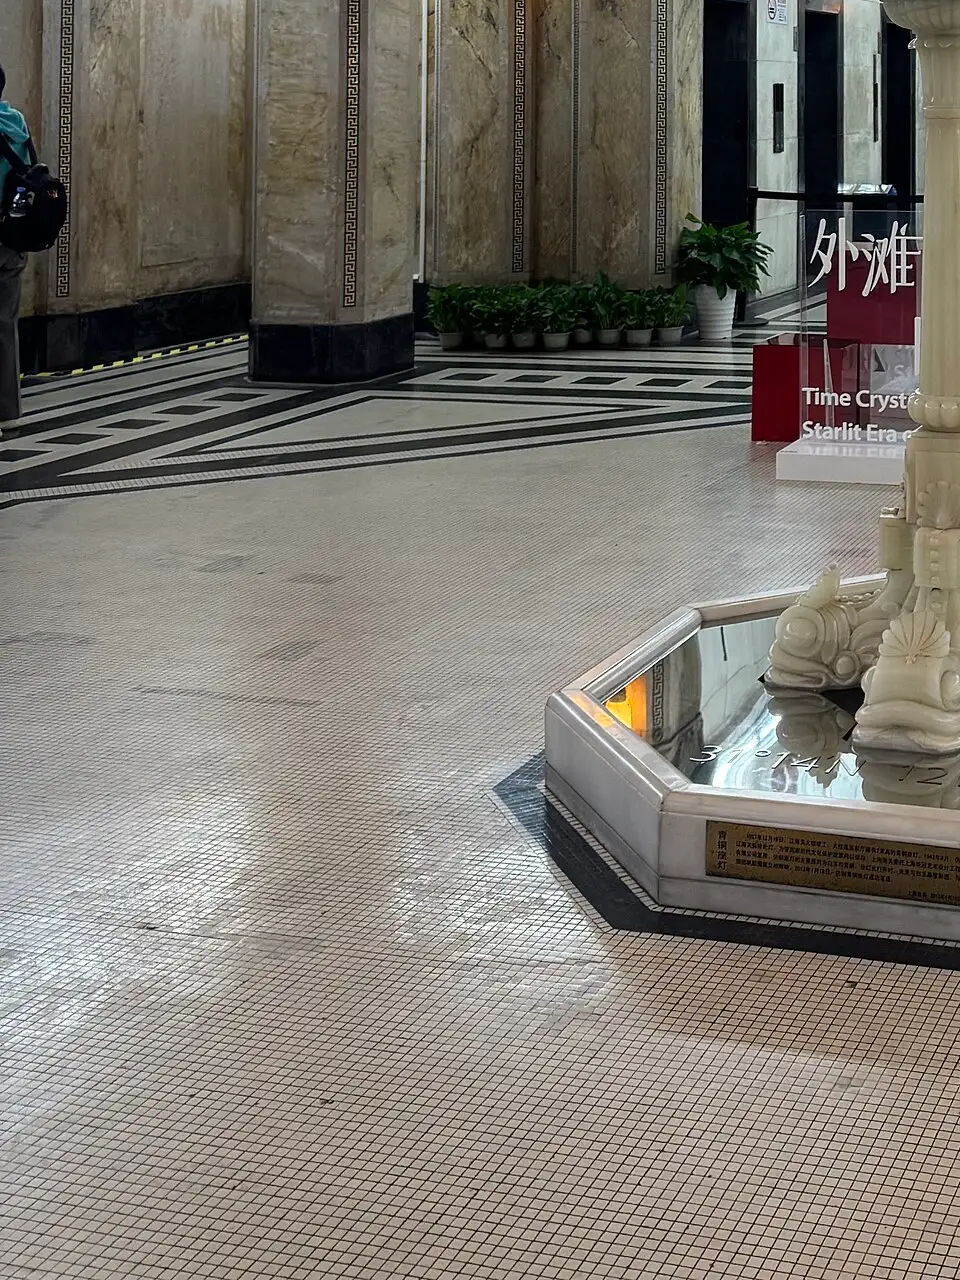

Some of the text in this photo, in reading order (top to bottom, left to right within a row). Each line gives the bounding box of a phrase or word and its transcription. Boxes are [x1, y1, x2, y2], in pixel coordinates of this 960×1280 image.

[802, 387, 911, 413] Time Cryst
[802, 420, 861, 441] Starlit
[866, 425, 897, 443] Era
